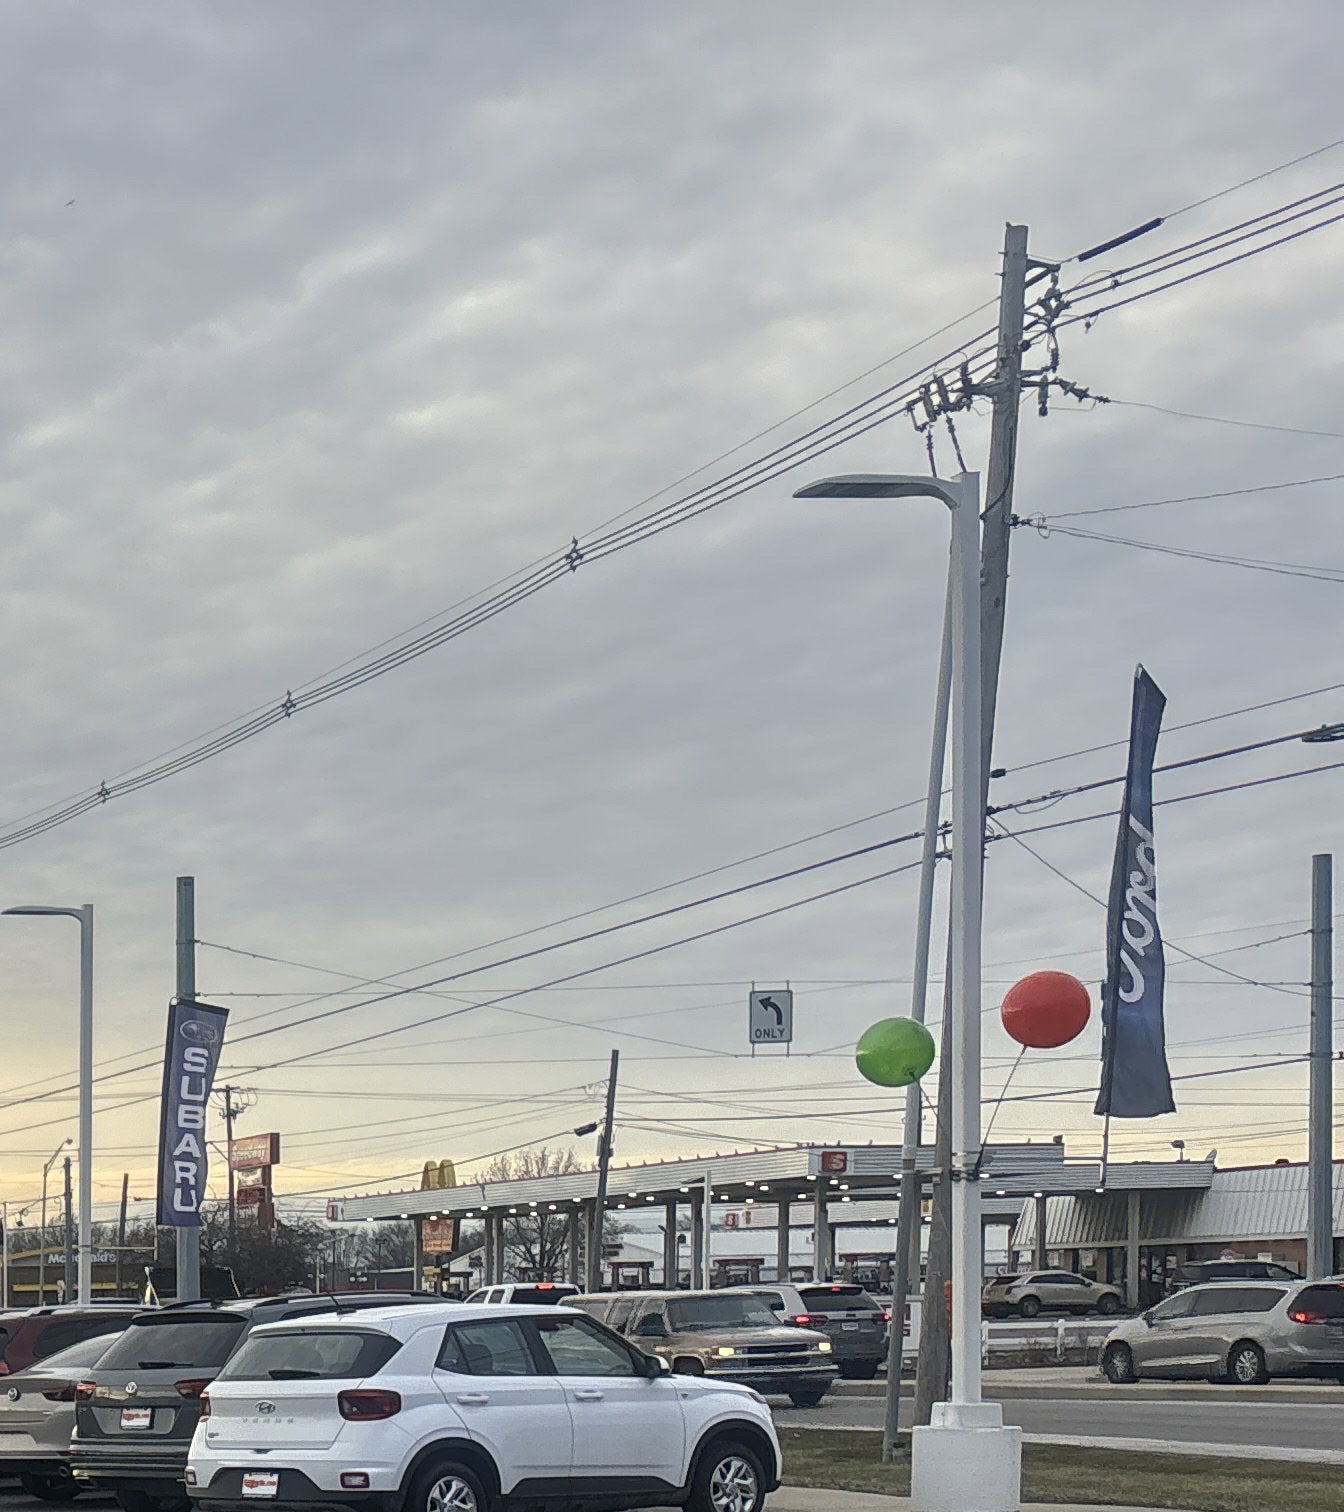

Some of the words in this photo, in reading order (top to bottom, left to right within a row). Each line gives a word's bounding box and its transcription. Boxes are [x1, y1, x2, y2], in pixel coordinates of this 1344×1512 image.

[754, 1028, 785, 1039] ONLY
[173, 1047, 209, 1212] SUBARU
[830, 1153, 845, 1170] S
[48, 1252, 117, 1264] Mcoald's
